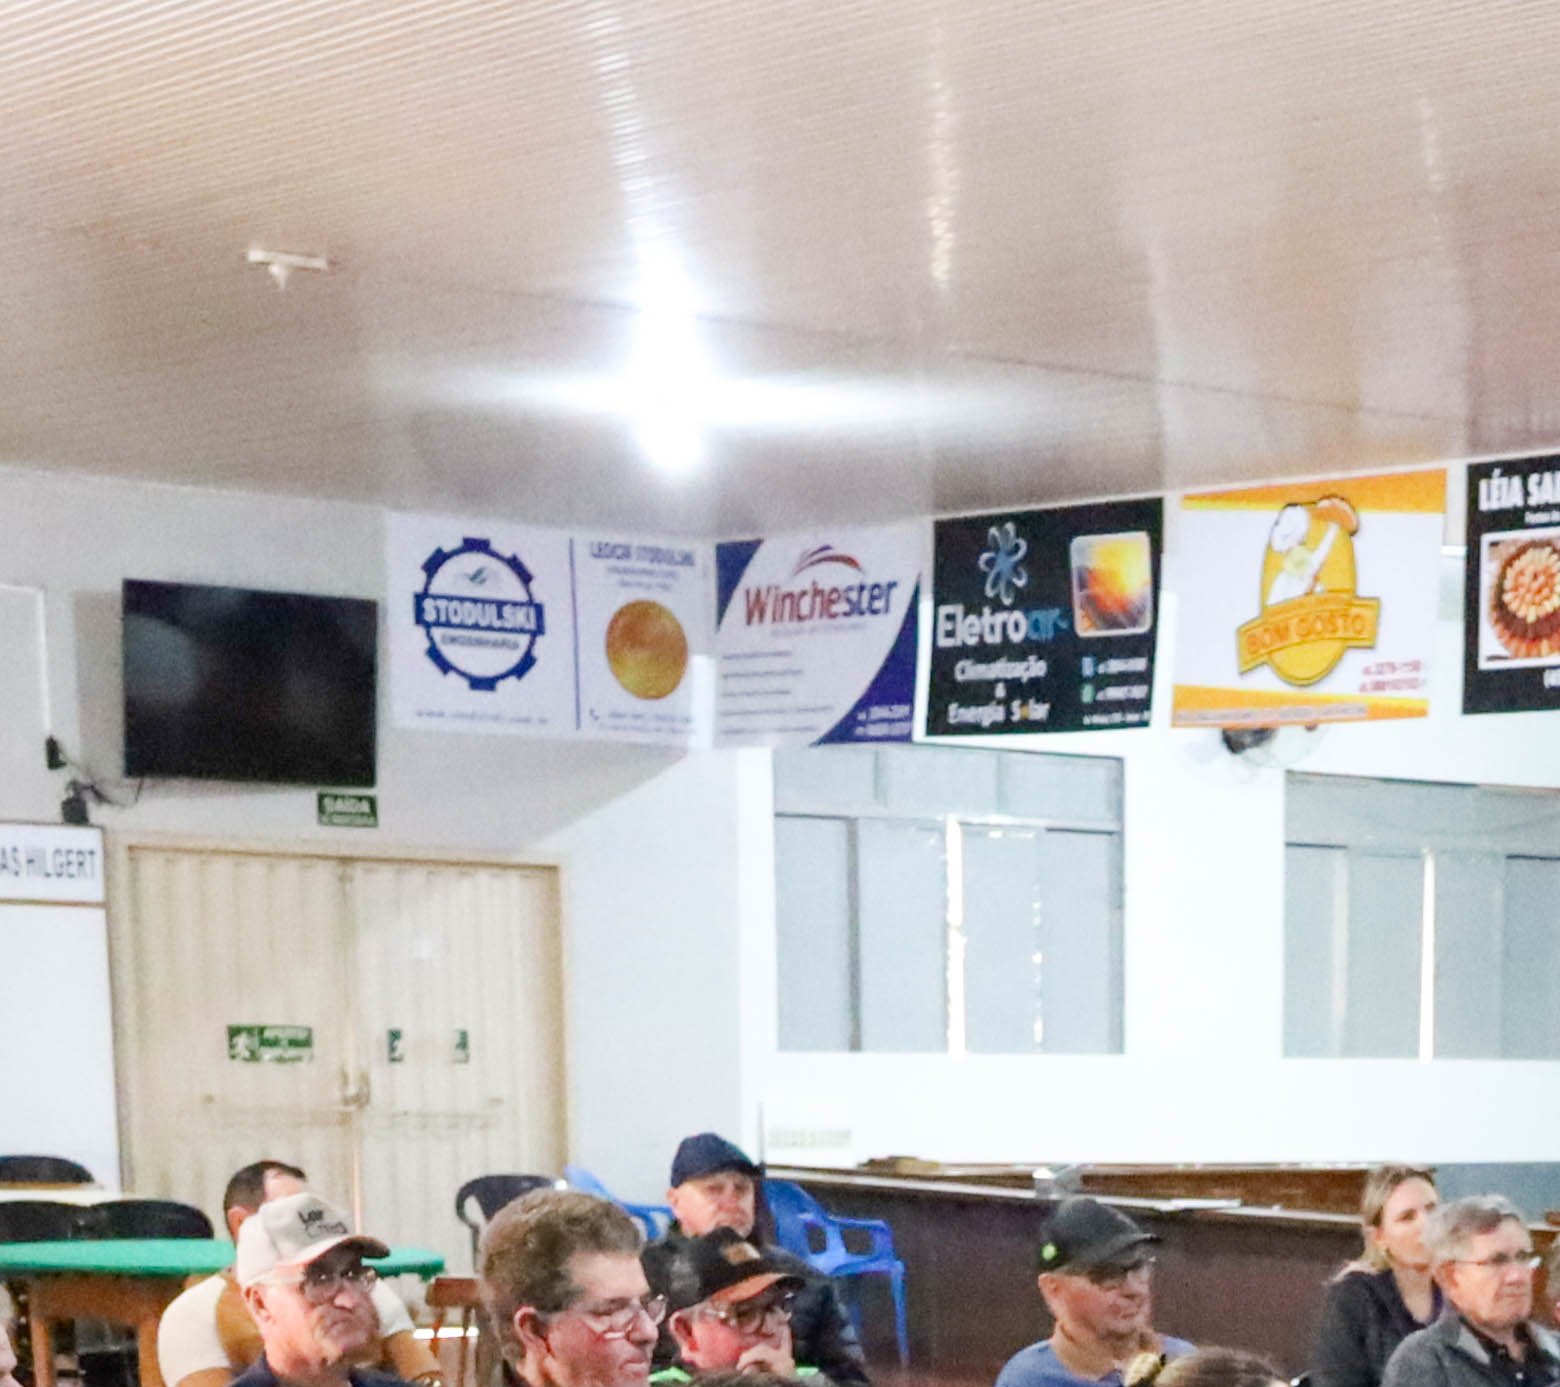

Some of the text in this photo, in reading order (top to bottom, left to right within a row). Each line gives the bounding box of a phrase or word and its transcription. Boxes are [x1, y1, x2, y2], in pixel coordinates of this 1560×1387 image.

[421, 596, 536, 631] STODULSKI
[744, 578, 898, 626] Winchester
[25, 847, 96, 878] HILGERT
